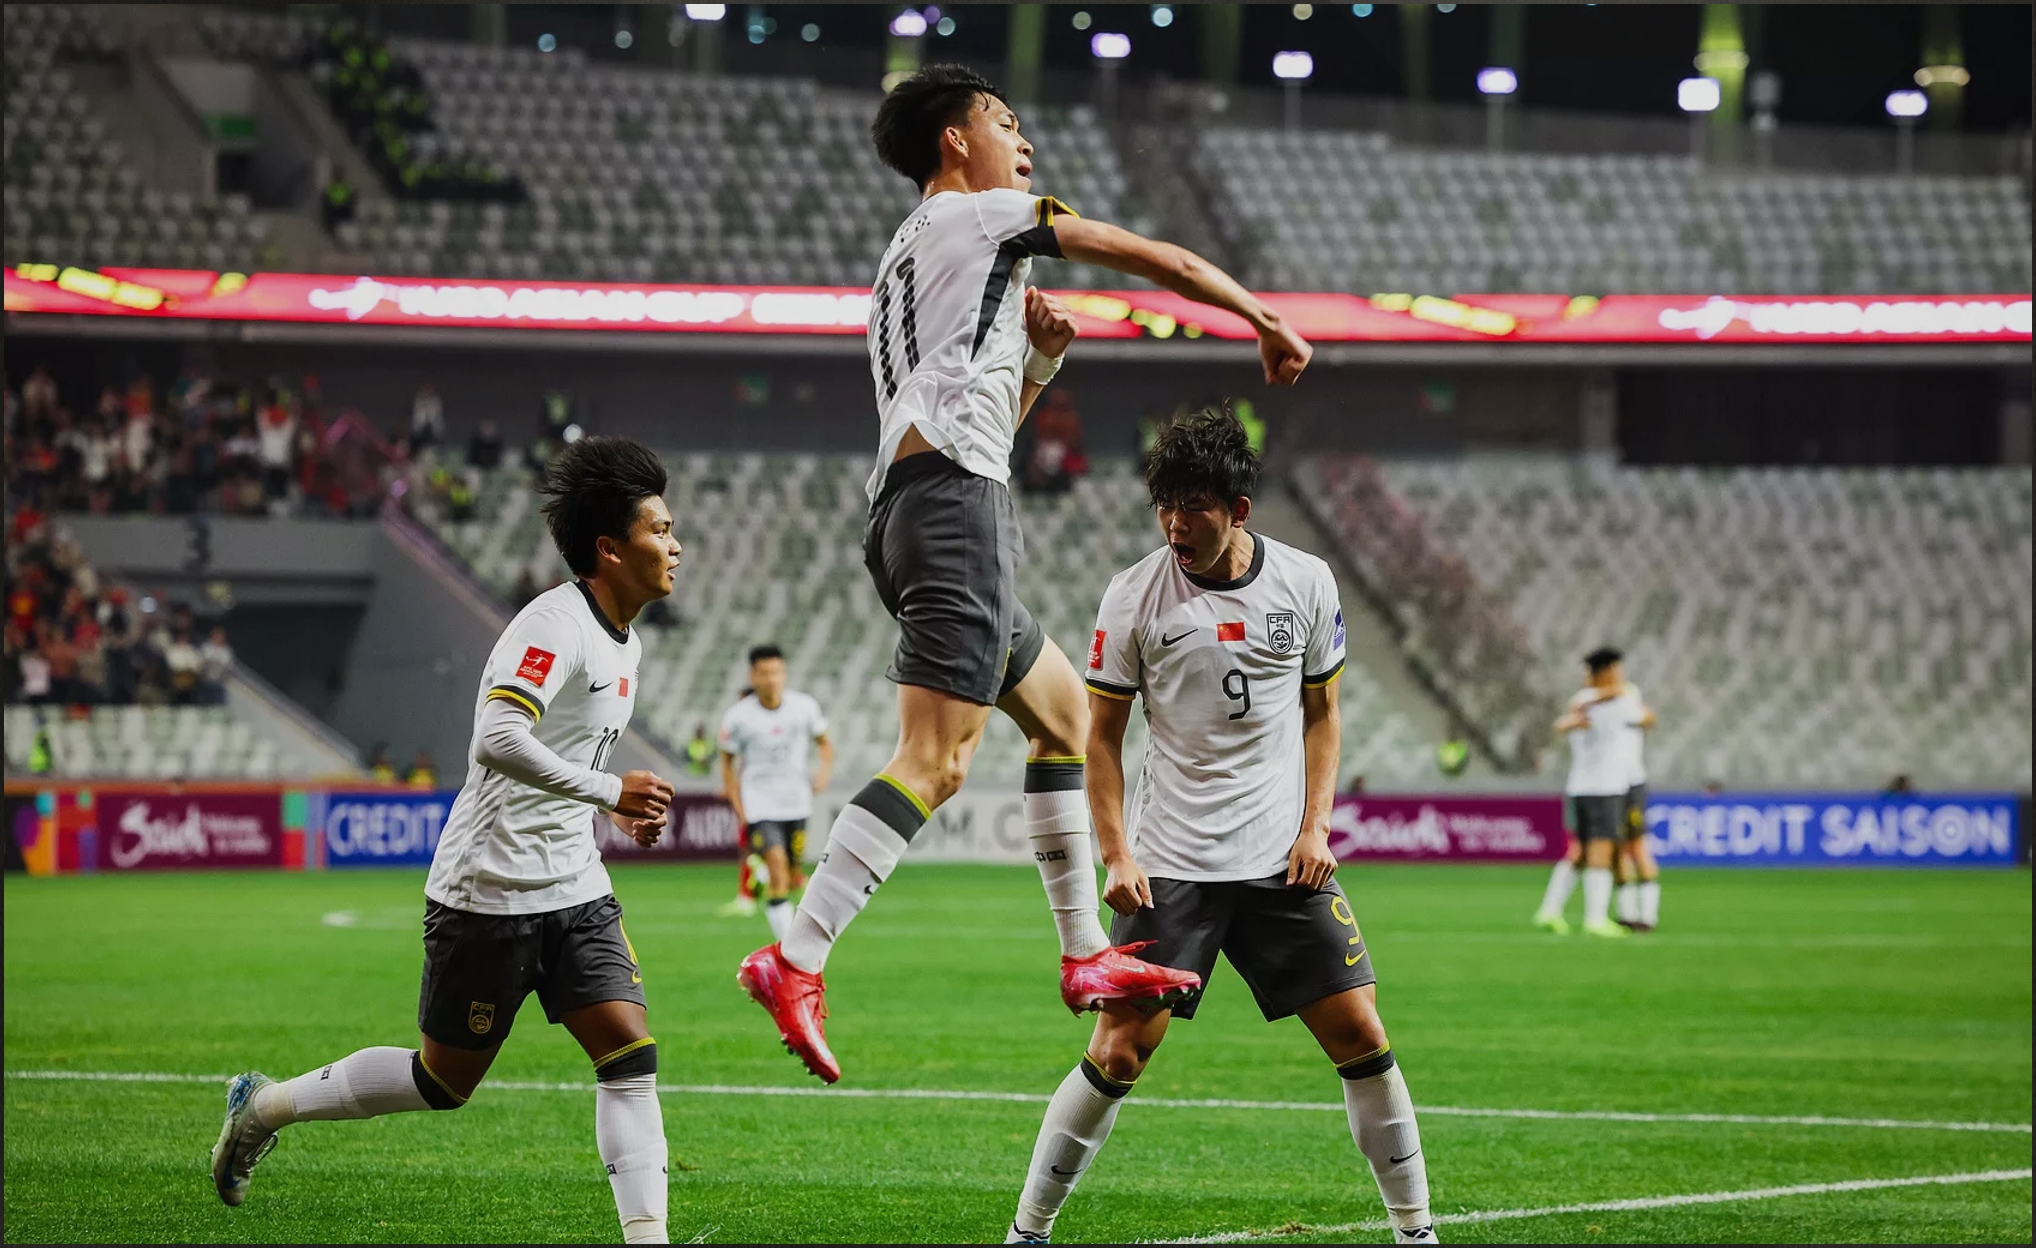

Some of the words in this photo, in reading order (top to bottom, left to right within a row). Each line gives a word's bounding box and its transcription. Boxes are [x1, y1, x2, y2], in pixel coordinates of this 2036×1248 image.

[877, 257, 921, 401] 11
[1269, 616, 1291, 624] CFA
[1221, 668, 1252, 721] 9
[590, 726, 619, 772] 10
[327, 802, 447, 857] CREDIT
[1645, 803, 1813, 857] CREDIT
[1818, 803, 2011, 857] SAISON
[1330, 896, 1360, 946] 9
